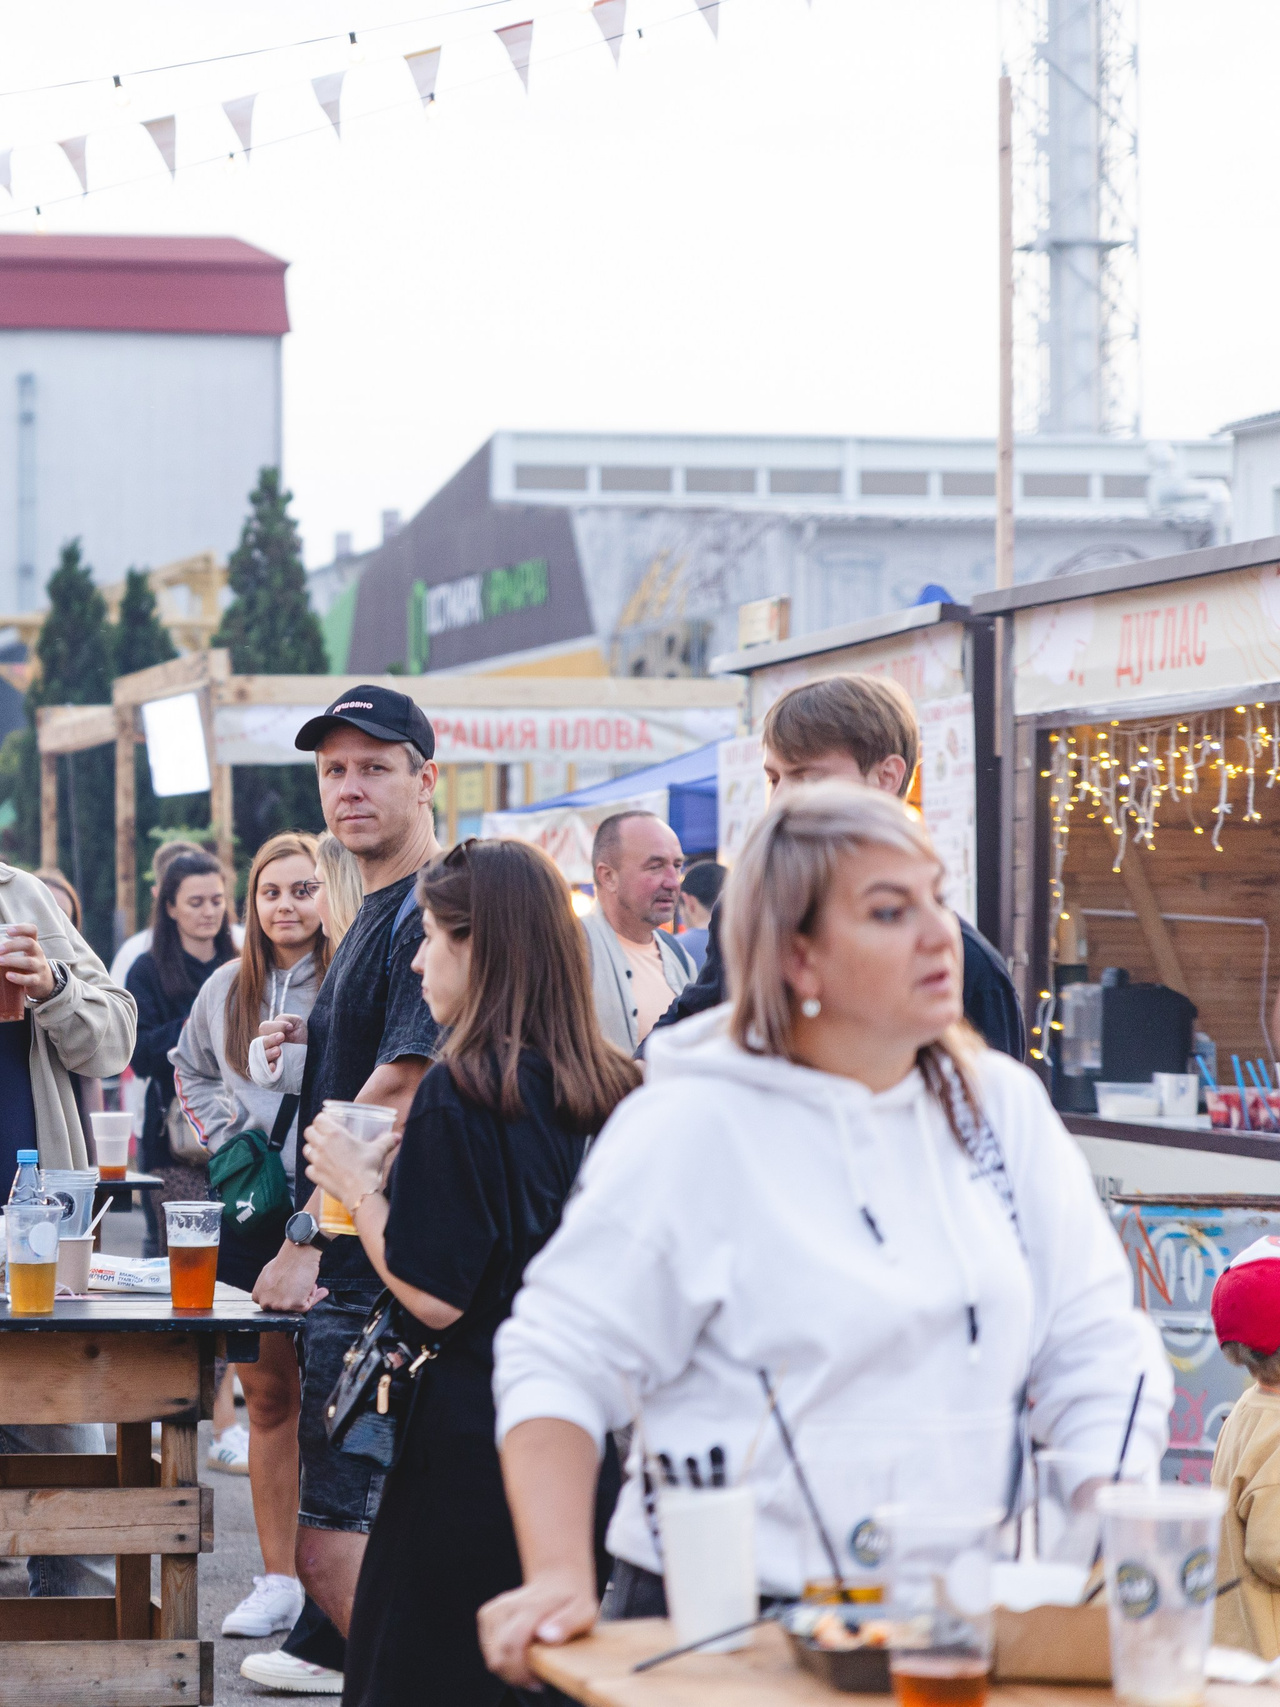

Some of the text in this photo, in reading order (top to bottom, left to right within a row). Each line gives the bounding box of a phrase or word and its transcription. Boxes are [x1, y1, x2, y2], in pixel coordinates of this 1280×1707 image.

[1116, 601, 1208, 687] ДУГЛАС
[432, 718, 654, 753] РАЦИЯ ПЛОВА
